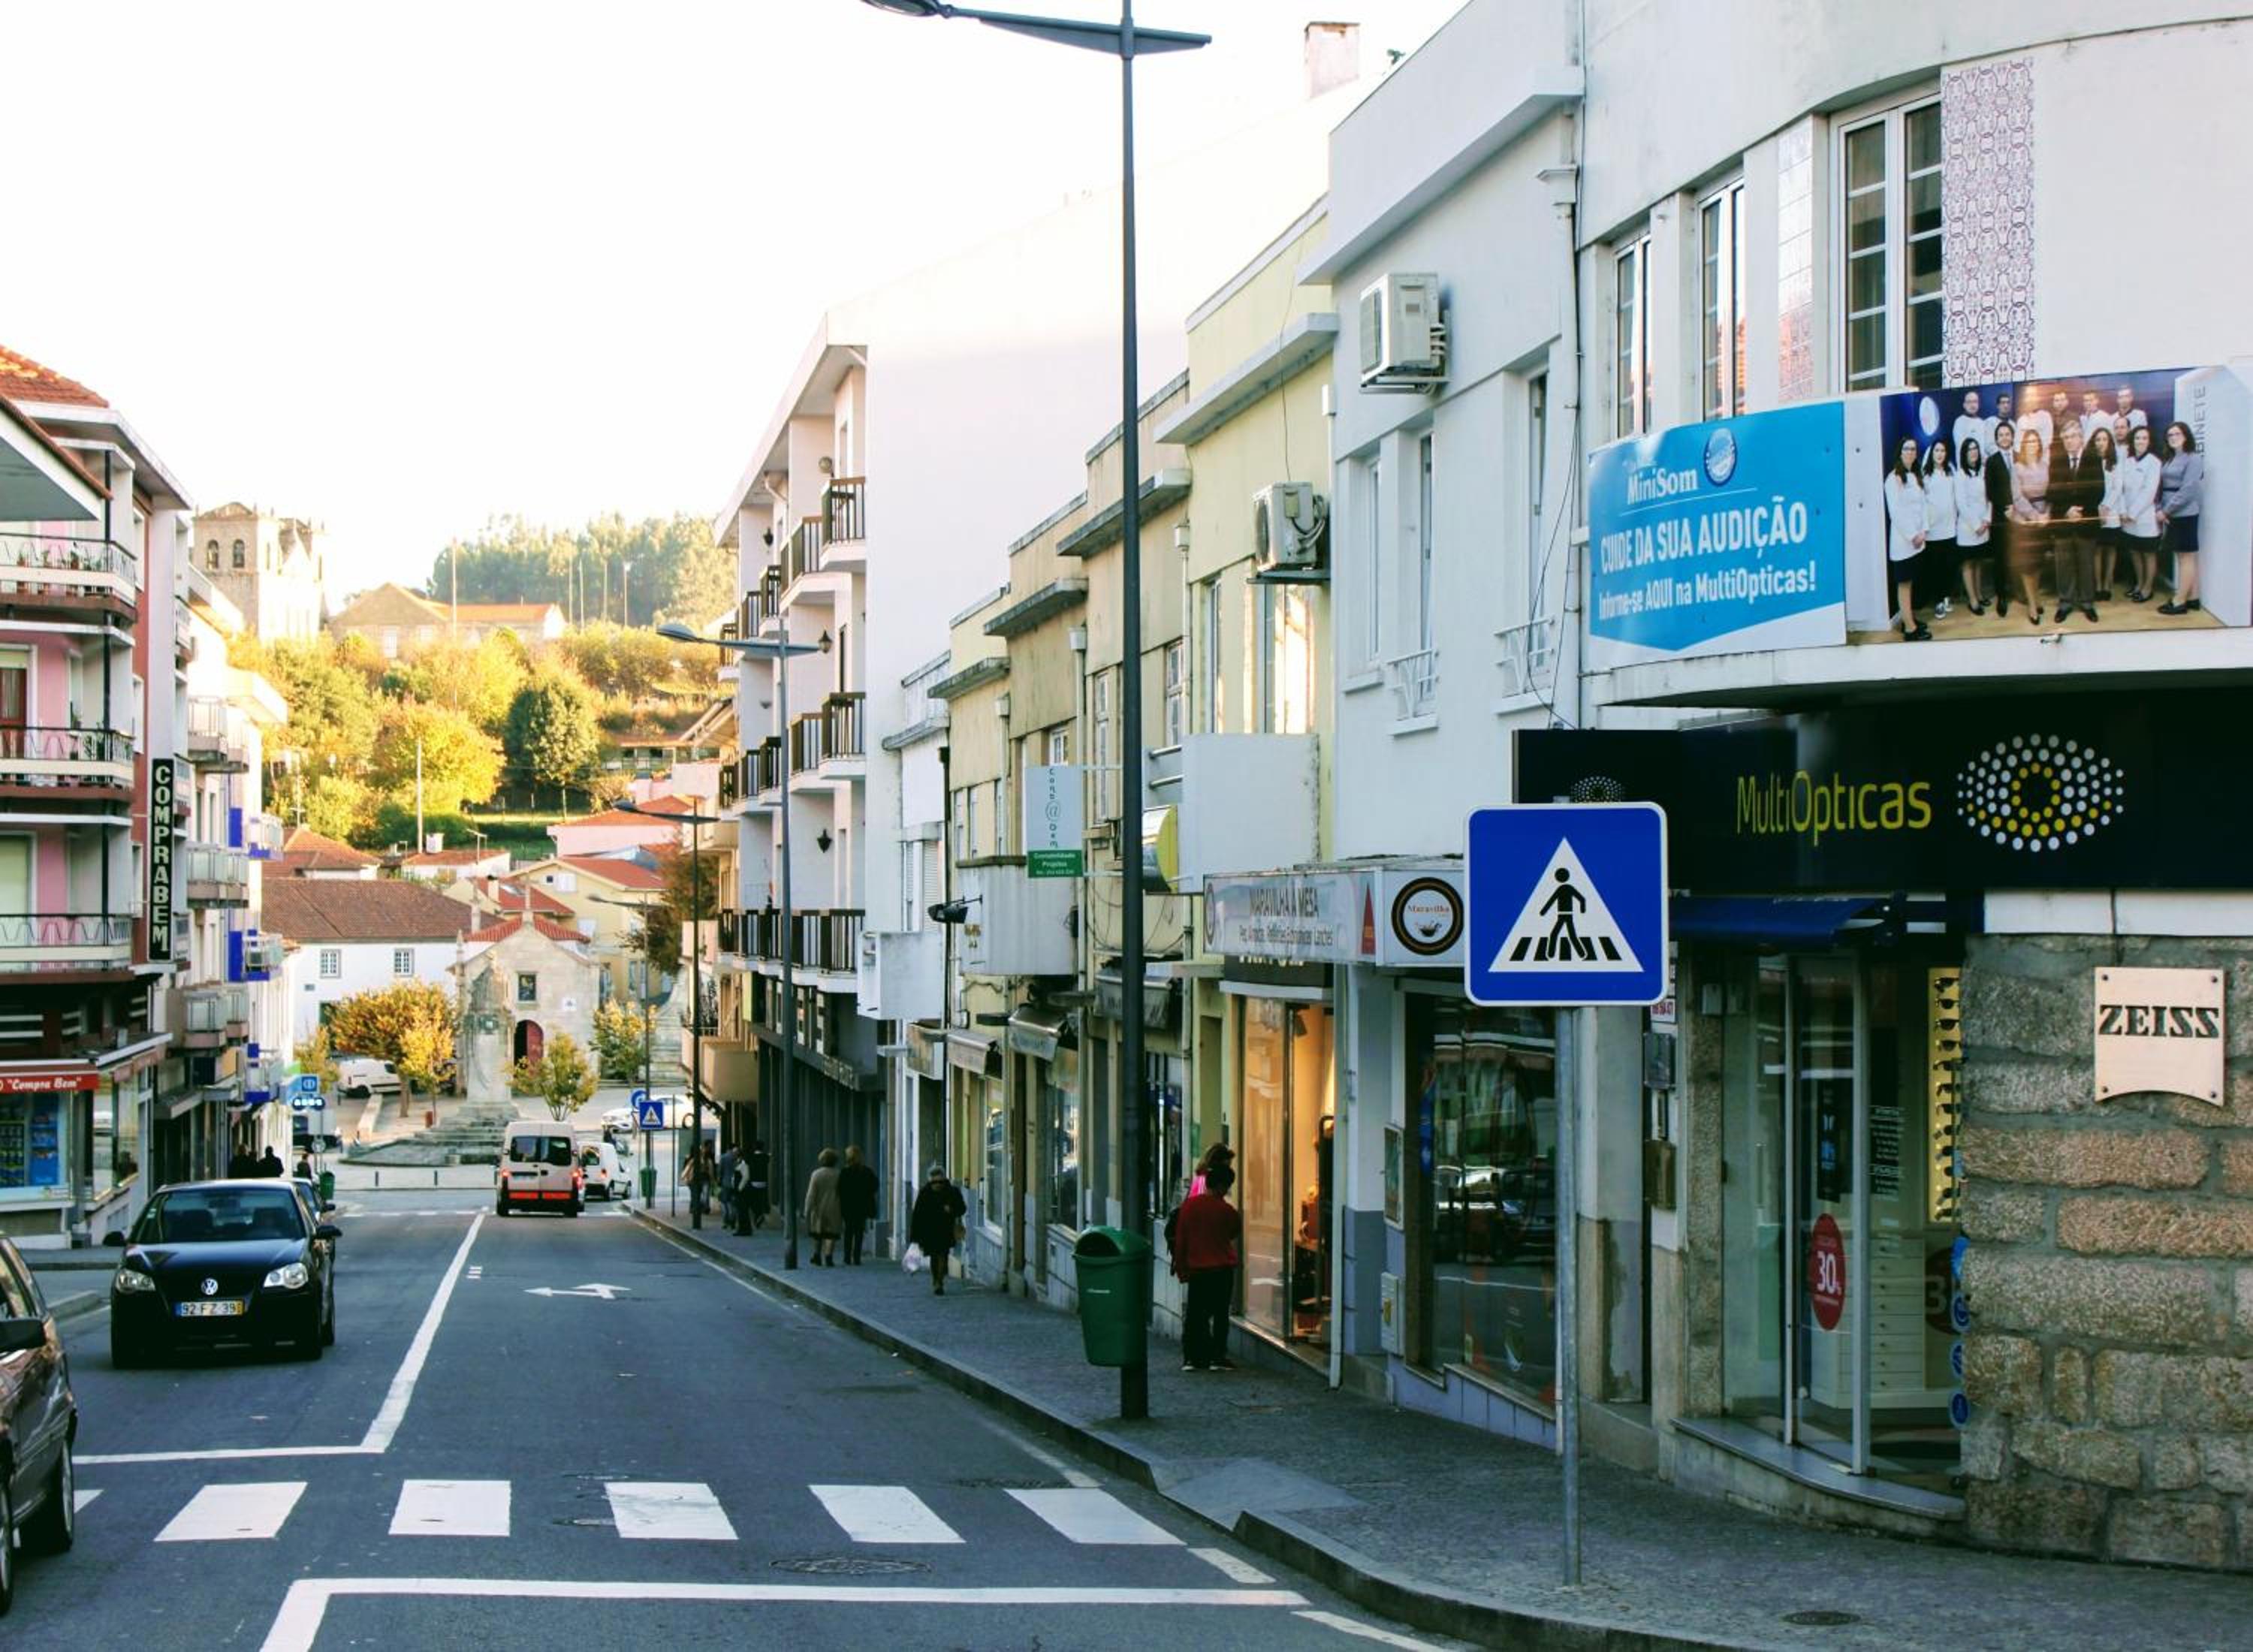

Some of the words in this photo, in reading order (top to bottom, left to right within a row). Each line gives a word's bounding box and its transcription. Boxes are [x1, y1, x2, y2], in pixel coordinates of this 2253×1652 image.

[1627, 468, 1698, 505] MiniSom
[1600, 532, 1632, 574] CUIDE
[1635, 526, 1654, 565] DA
[1657, 518, 1693, 562] SUA
[1697, 496, 1808, 559] AUDIÇÃO
[1645, 577, 1673, 610] AQUI
[1676, 580, 1692, 606] na
[1695, 560, 1816, 604] MultiOpticas!
[1737, 770, 1932, 846] MultiOpticas
[2099, 1005, 2219, 1038] ZEISS
